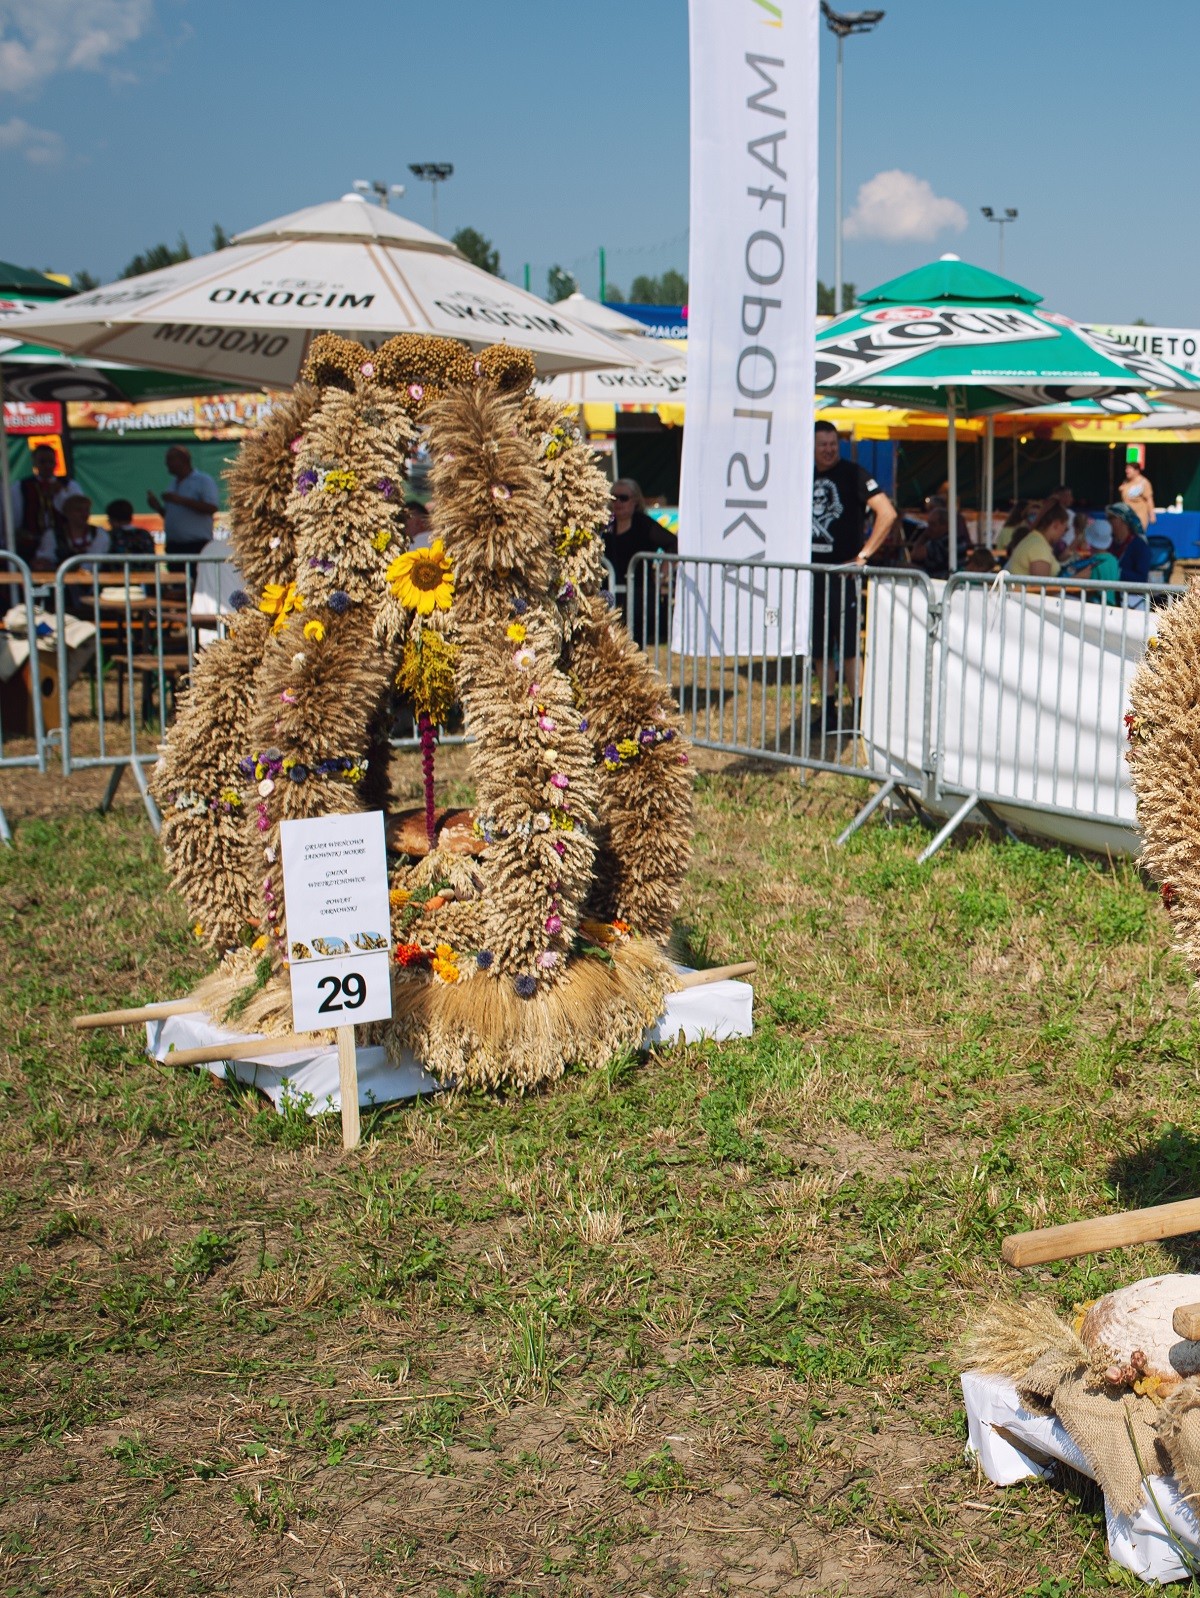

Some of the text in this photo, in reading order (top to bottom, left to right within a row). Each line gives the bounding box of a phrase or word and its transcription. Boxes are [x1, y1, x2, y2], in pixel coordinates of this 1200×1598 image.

[209, 288, 375, 308] OKOCIM
[434, 300, 573, 336] OKOCIM
[317, 972, 367, 1014] 29
